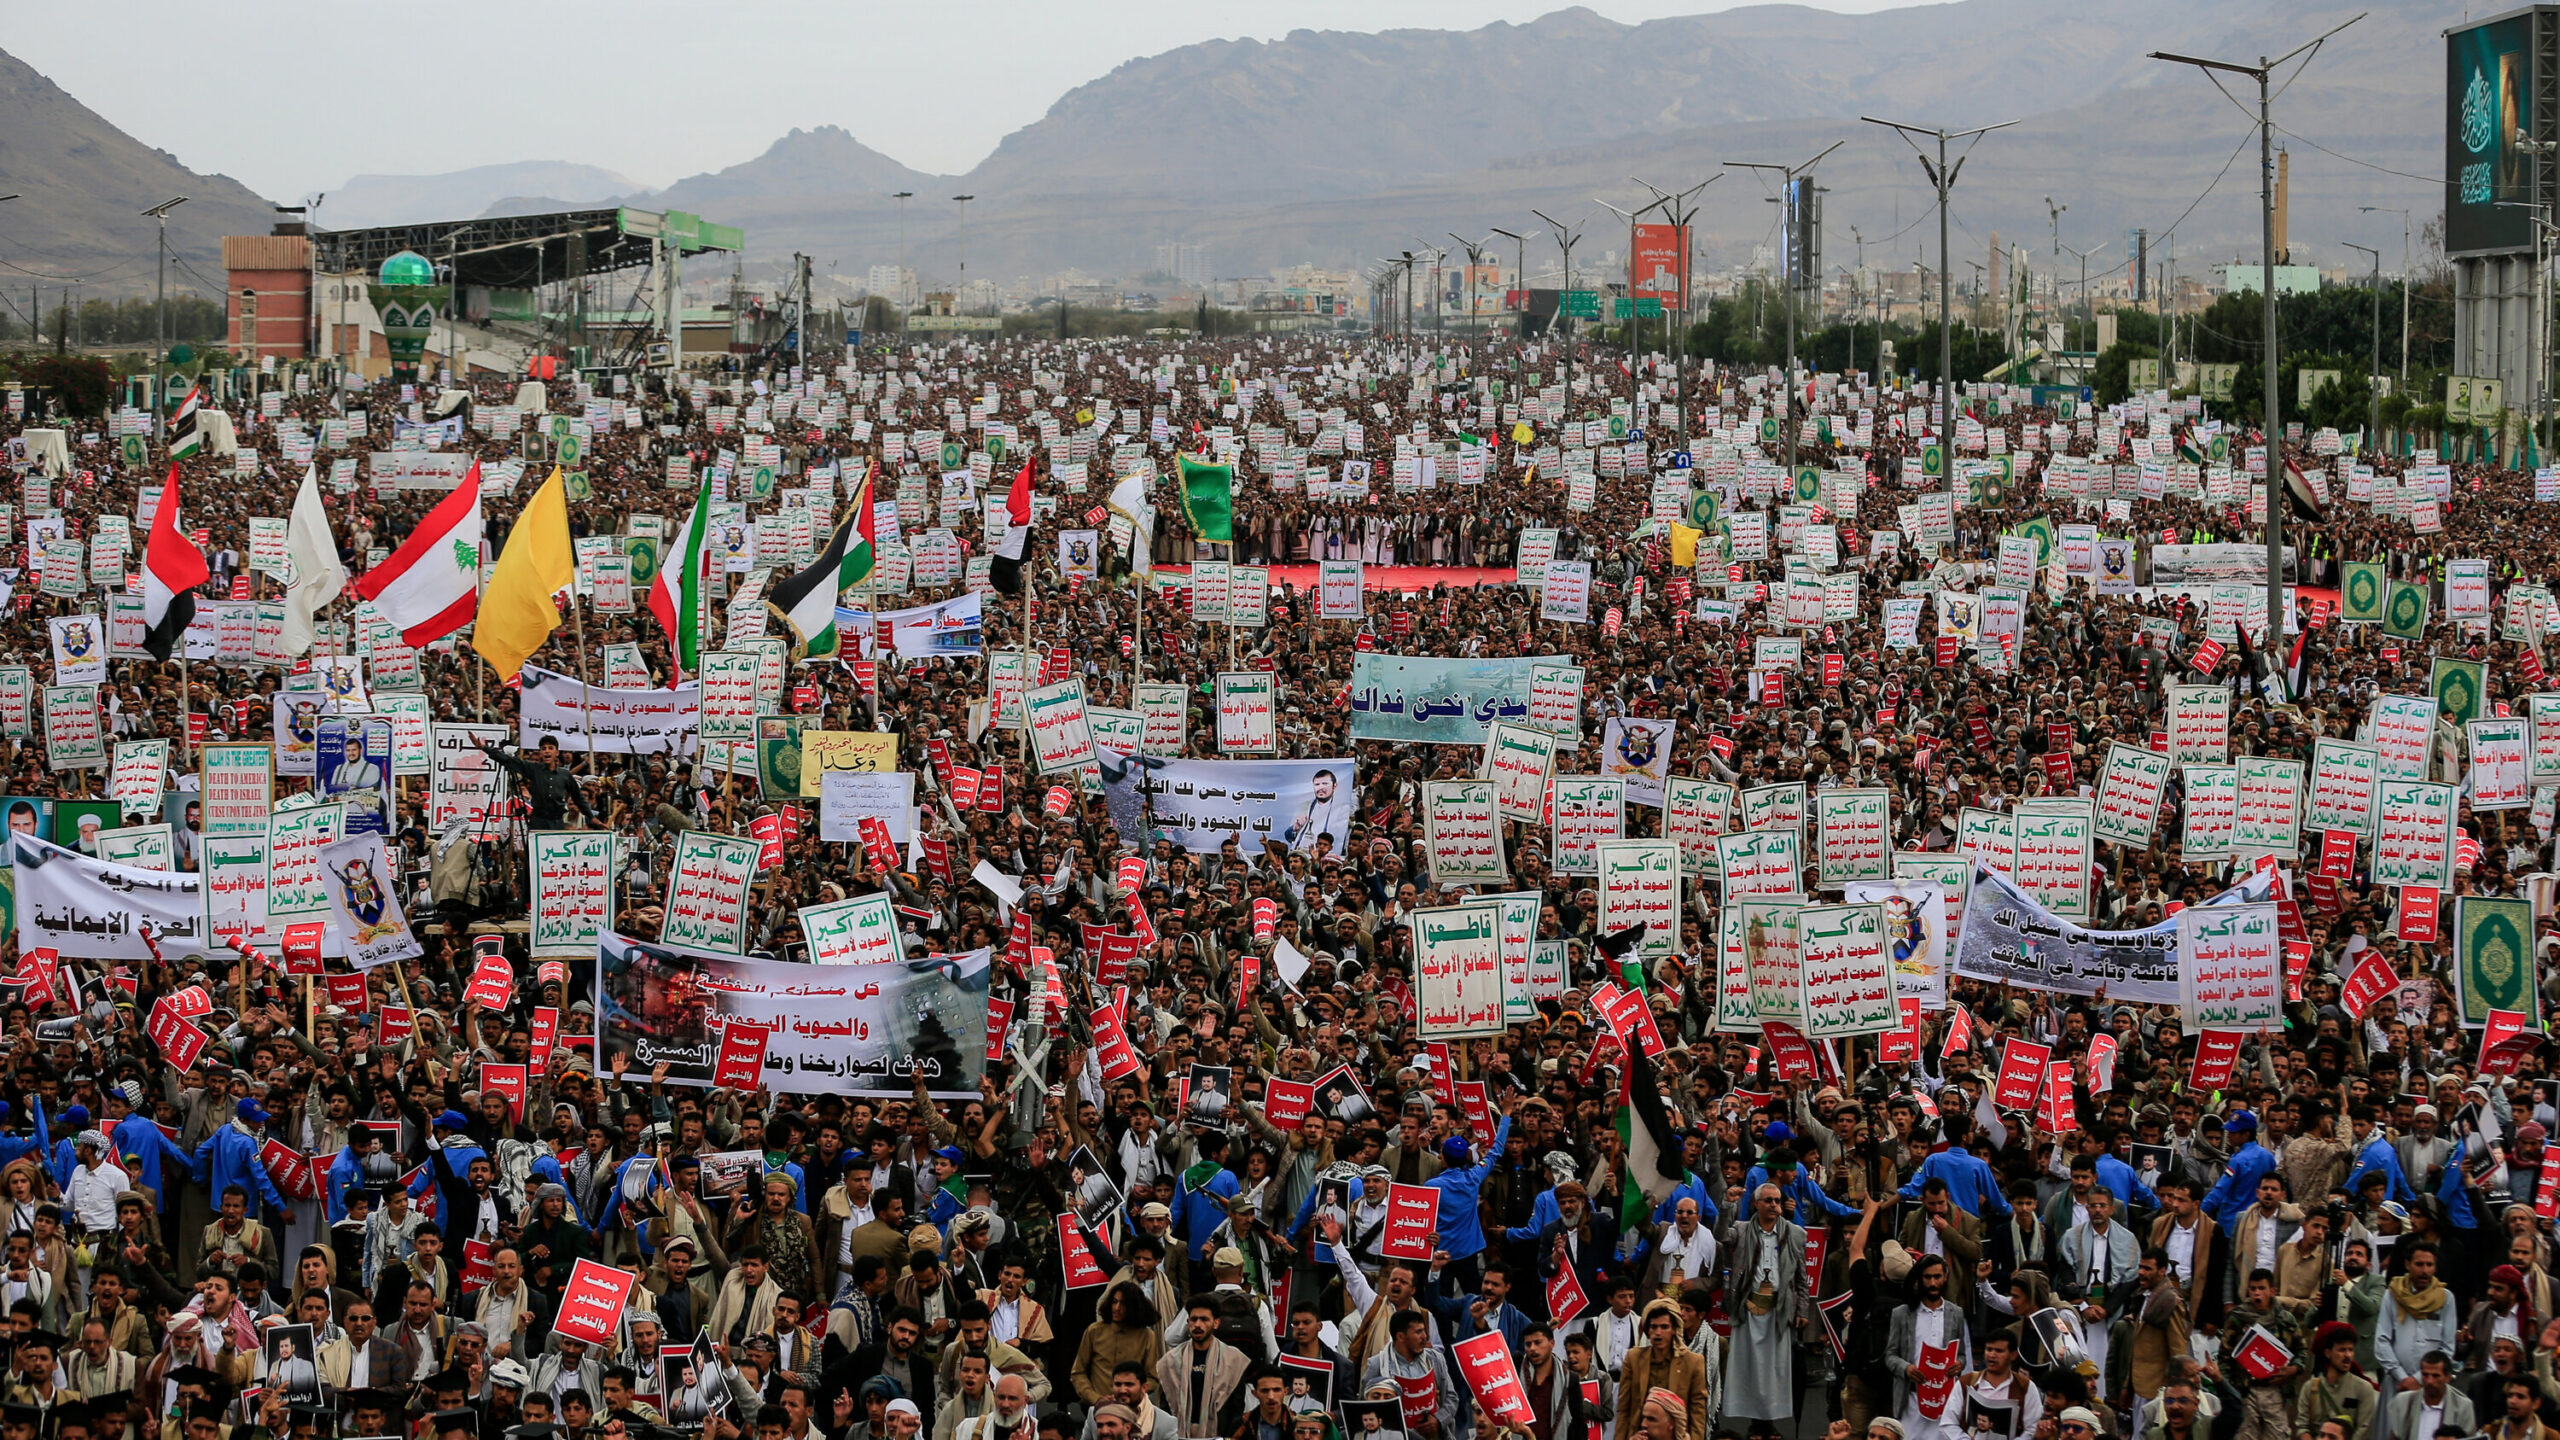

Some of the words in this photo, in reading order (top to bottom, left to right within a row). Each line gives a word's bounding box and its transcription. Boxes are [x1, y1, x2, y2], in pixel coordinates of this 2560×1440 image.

[1223, 678, 1268, 698] قاطعوا
[555, 698, 578, 708] نفسه
[678, 702, 699, 715] على
[1248, 700, 1271, 715] البضائع
[1351, 687, 1405, 714] فداك
[1412, 692, 1464, 723] نحن
[628, 702, 674, 717] السعودي
[1473, 695, 1527, 730] يدي
[564, 723, 579, 734] في
[1243, 716, 1247, 729] و
[628, 725, 661, 738] حصارنا
[208, 750, 224, 766] ALLAH
[232, 750, 241, 766] THE
[243, 750, 268, 766] GREATEST
[208, 773, 229, 784] DEATH
[230, 773, 238, 784] TO
[240, 773, 266, 784] AMERICA
[1133, 777, 1170, 794] الفاء
[208, 789, 229, 800] DEATH
[230, 789, 238, 800] TO
[240, 789, 261, 800] ISRAEL
[438, 779, 479, 795] جبريل
[1174, 782, 1193, 795] لك
[1199, 785, 1227, 799] نحن
[1474, 787, 1491, 803] الله
[1232, 790, 1276, 805] سيدي
[208, 806, 225, 817] CURSE
[227, 806, 240, 817] UPON
[242, 806, 252, 817] THE
[252, 806, 267, 817] JEWS
[1465, 811, 1491, 823] الموت
[1201, 815, 1248, 832] الجنود
[1252, 817, 1271, 832] لك
[1467, 829, 1492, 841] الموت
[684, 840, 728, 862] أكبر
[726, 846, 753, 865] الله
[1437, 847, 1459, 858] اليهود
[1460, 846, 1474, 857] على
[1476, 844, 1495, 856] اللعنة
[1439, 860, 1470, 875] للإسلام
[1475, 860, 1498, 875] النصر
[719, 872, 745, 885] الموت
[715, 892, 741, 905] الموت
[674, 904, 701, 919] اليهود
[702, 908, 714, 921] على
[718, 909, 739, 925] اللعنة
[1992, 908, 2017, 929] الله
[34, 903, 130, 942] الإيمانية
[1804, 909, 1859, 945] أكبر
[1858, 911, 1880, 934] الله
[2019, 913, 2061, 938] سبيل
[2194, 913, 2240, 943] أكبر
[2242, 914, 2270, 934] الله
[669, 920, 706, 943] للإسلام
[707, 927, 737, 945] النصر
[1422, 913, 1492, 949] قاطعوا
[1848, 942, 1883, 958] الموت
[1990, 943, 2046, 970] الموقف
[2238, 944, 2271, 960] الموت
[1421, 950, 1460, 980] الأمريكية
[1464, 944, 1498, 976] البضائع
[1850, 965, 1885, 982] الموت
[2049, 959, 2074, 980] في
[2080, 961, 2125, 982] وتأثير
[2240, 964, 2272, 981] الموت
[696, 974, 766, 994] النفطية
[854, 981, 880, 999] كل
[1457, 979, 1462, 998] و
[2248, 984, 2274, 997] اللعنة
[1810, 991, 1839, 1009] اليهود
[1842, 990, 1860, 1006] على
[1863, 987, 1888, 1001] اللعنة
[2197, 987, 2225, 1002] اليهود
[2229, 985, 2244, 1001] على
[1424, 1002, 1501, 1028] الإسرائيلية
[1812, 1008, 1855, 1032] للإسلام
[1860, 1005, 1891, 1027] النصر
[2199, 1006, 2237, 1024] للإسلام
[2240, 1002, 2276, 1023] النصر
[793, 1014, 869, 1040] والحيوية
[732, 1033, 760, 1047] جمعة
[2207, 1038, 2234, 1051] جمعة
[636, 1038, 711, 1065] المسيرة
[725, 1050, 758, 1064] التحذير
[2011, 1049, 2040, 1066] جمعة
[799, 1053, 888, 1078] لصواريخنا
[2201, 1056, 2232, 1067] التحذير
[722, 1068, 752, 1081] والنفير
[2005, 1070, 2037, 1082] التحذير
[2199, 1072, 2225, 1082] والنفير
[2002, 1087, 2031, 1101] والنفير
[1397, 1195, 1430, 1211] جمعة
[1393, 1216, 1429, 1228] التحذير
[1391, 1235, 1425, 1249] والنفير
[583, 1272, 620, 1293] جمعة
[573, 1293, 615, 1311] التحذير
[568, 1313, 606, 1334] والنفير
[1469, 1348, 1505, 1367] جمعة
[1481, 1370, 1513, 1395] التحذير
[1492, 1395, 1523, 1416] والنفير
